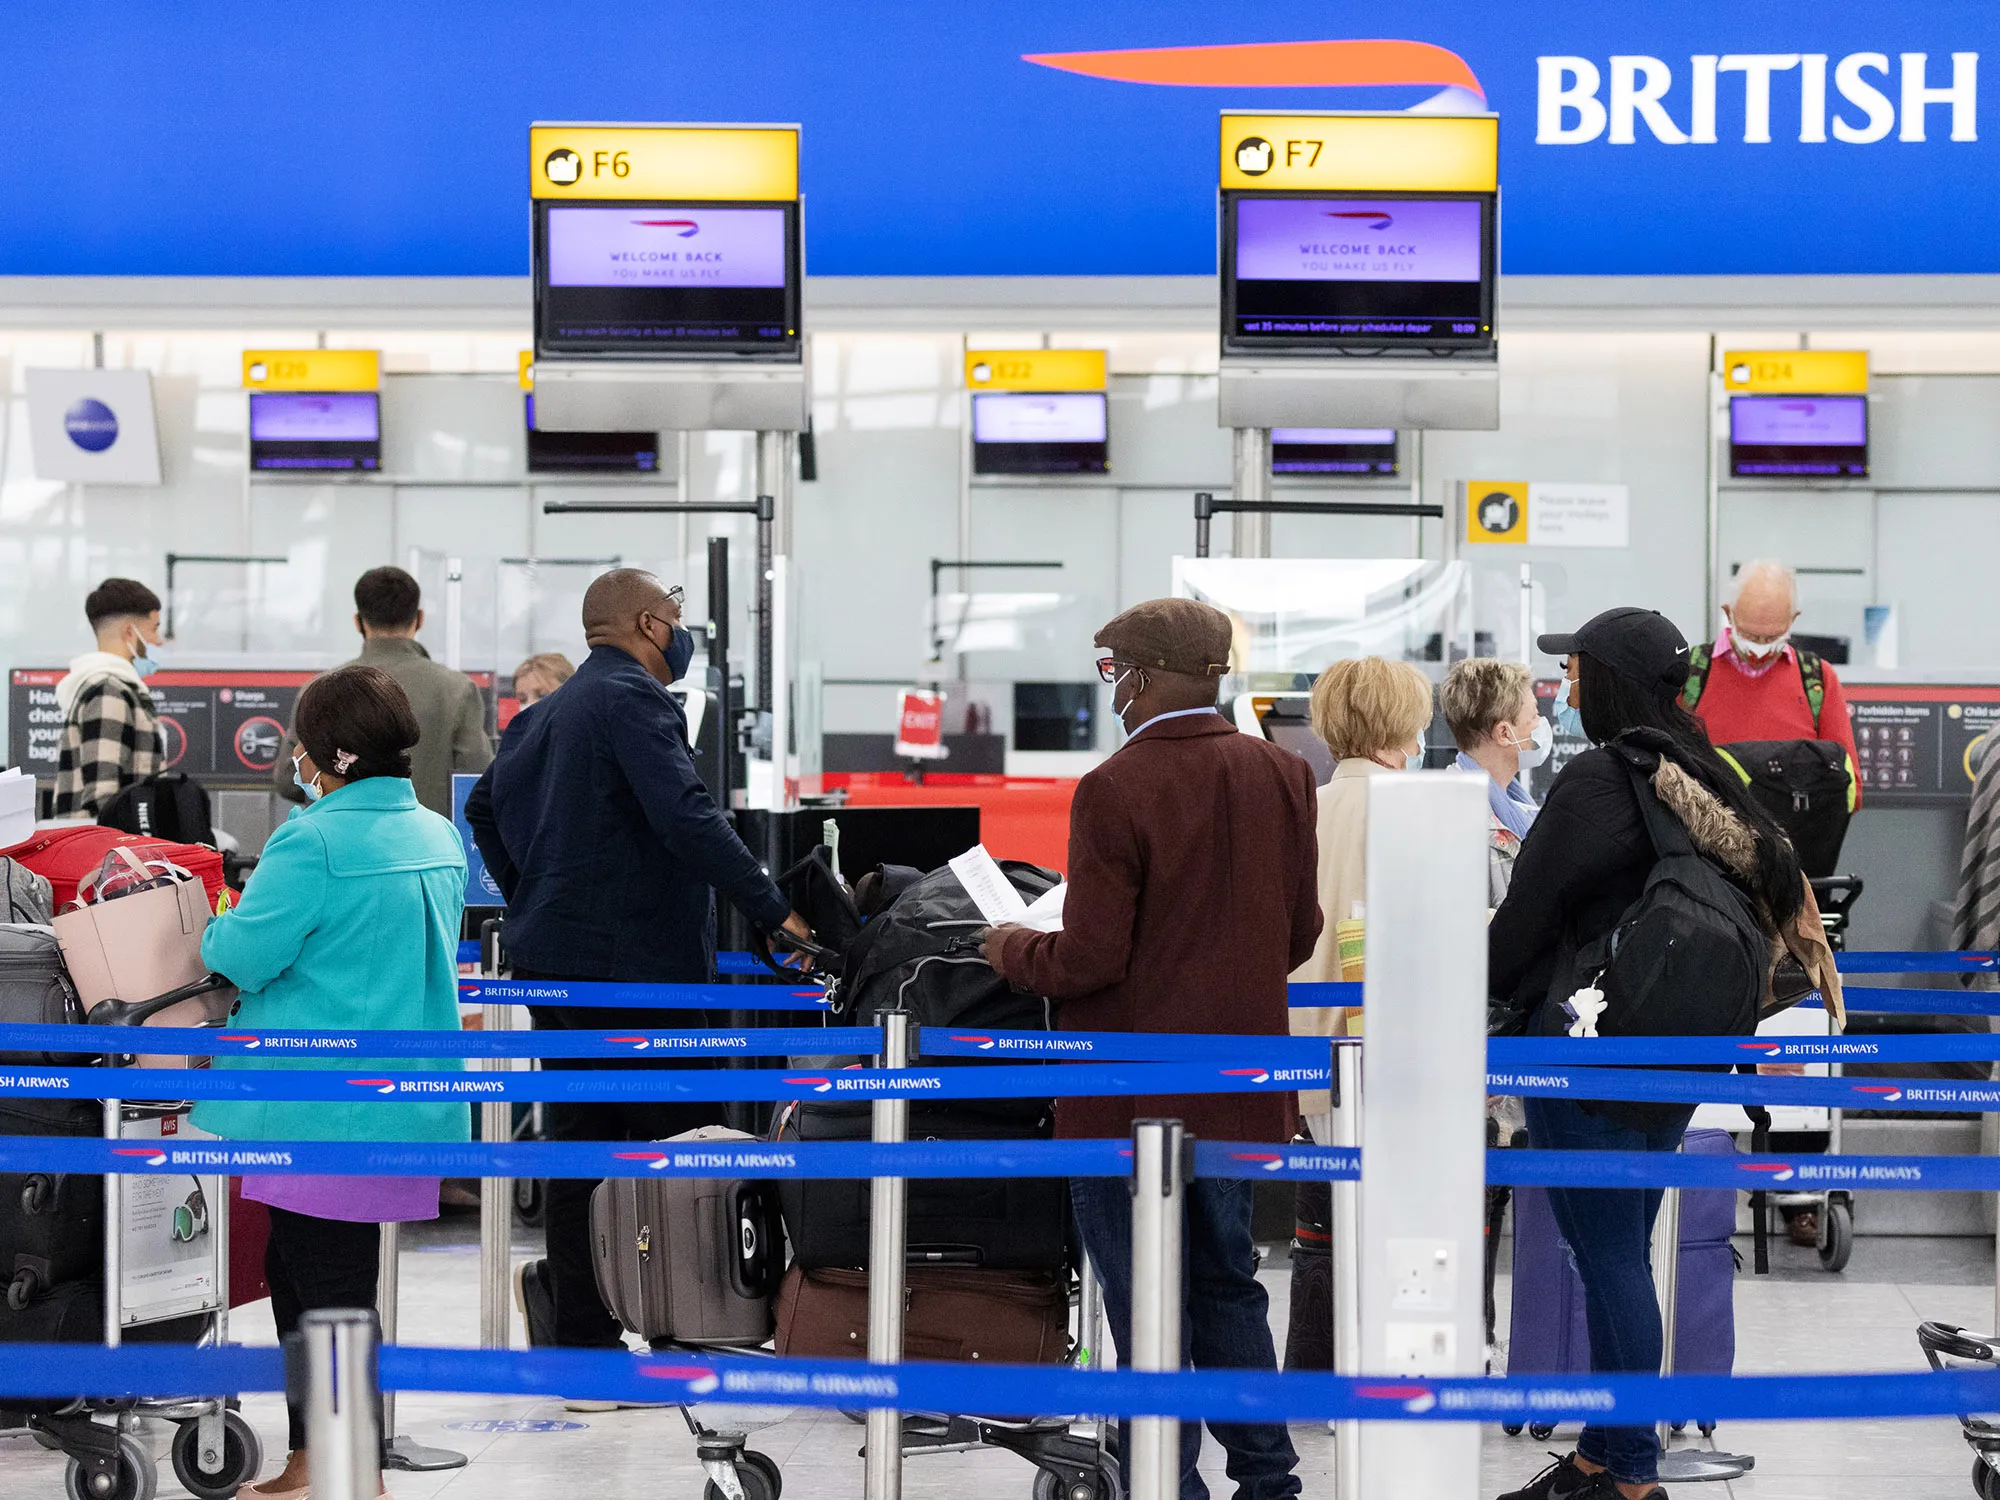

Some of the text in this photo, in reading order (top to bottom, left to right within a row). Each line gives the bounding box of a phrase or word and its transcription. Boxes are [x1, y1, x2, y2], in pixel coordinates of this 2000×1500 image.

[1536, 51, 1979, 145] BRITISH
[1285, 140, 1324, 168] F7
[593, 151, 630, 178] F6
[1300, 243, 1417, 255] WELCOME BACK
[610, 251, 723, 262] WELCOME BACK
[613, 268, 721, 278] YOU MAKE US FLY
[1302, 261, 1415, 272] YOU MAKE US FLY
[1274, 322, 1308, 331] minutes
[1310, 322, 1338, 332] before
[1361, 322, 1404, 332] scheduled
[29, 689, 57, 705] Hav
[1857, 705, 1930, 716] Forbidden items
[1964, 706, 1988, 717] Child
[138, 802, 151, 829] NIKE
[484, 987, 569, 999] BRITISH AIRWAYS
[264, 1037, 358, 1049] BRITISH AIRWAYS
[653, 1037, 747, 1049] BRITISH AIRWAYS
[998, 1038, 1094, 1051] BRITISH AIRWAYS
[1785, 1042, 1879, 1055] BRITISH AIRWAYS
[1273, 1068, 1324, 1081] BRITISH
[1486, 1073, 1570, 1089] TISH AIRWAYS
[16, 1076, 70, 1089] AIRWAYS
[399, 1081, 505, 1093] BRITISH AIRWAYS
[836, 1077, 942, 1092] BRITISH AIRWAYS
[1906, 1088, 2000, 1102] BRITISH AIRWA
[162, 1118, 177, 1133] AVIS
[172, 1151, 293, 1166] BRITISH AIRWAYS
[674, 1153, 796, 1169] BRITISH AIRWAYS
[1288, 1155, 1347, 1171] BRITISH
[1798, 1164, 1922, 1181] BRITISH AIRWAYS
[723, 1370, 899, 1398] BRITISH AIRWAYS
